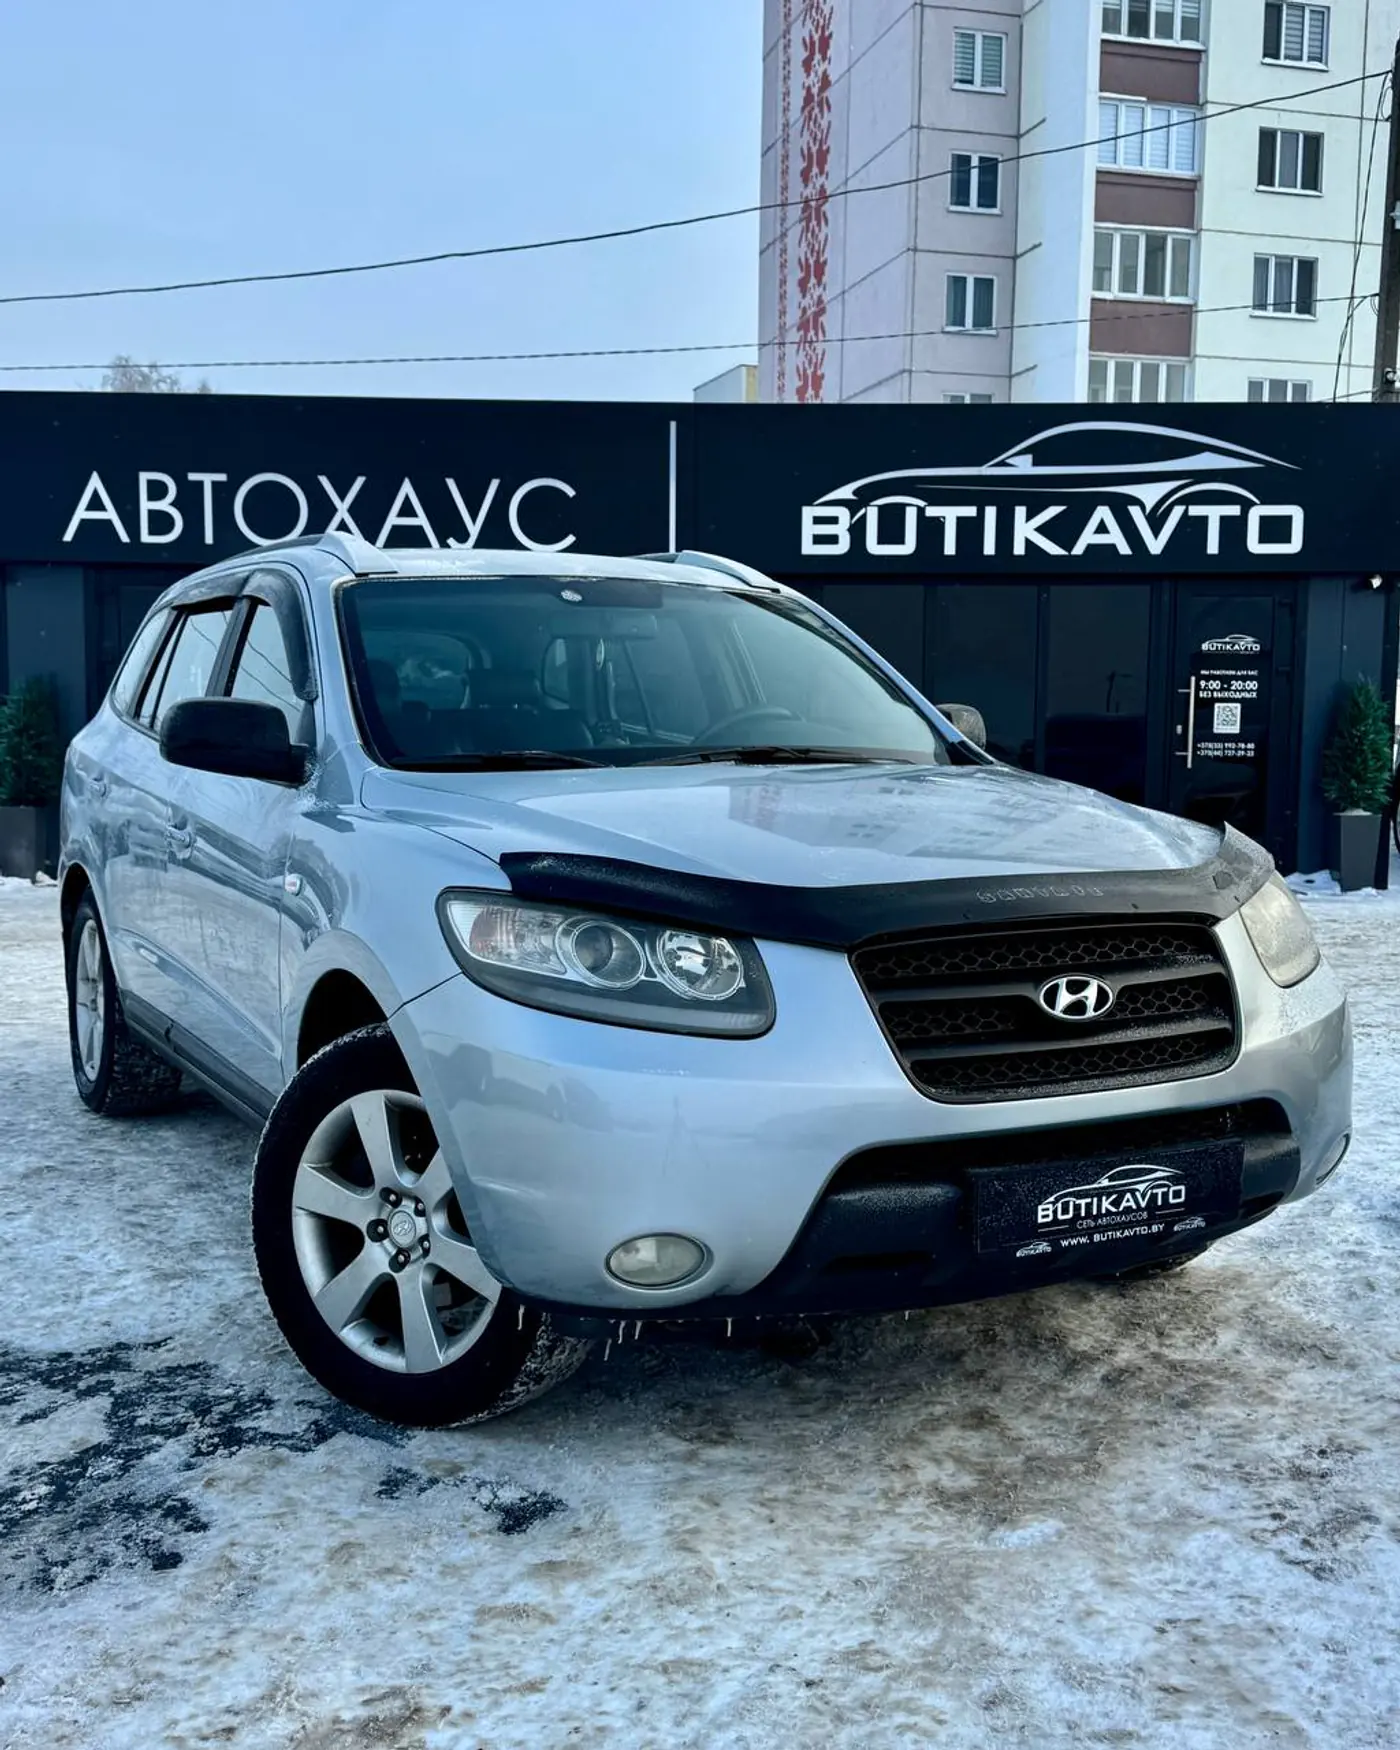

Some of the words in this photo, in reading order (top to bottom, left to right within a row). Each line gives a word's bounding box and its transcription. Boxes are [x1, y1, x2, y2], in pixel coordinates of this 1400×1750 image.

[62, 470, 577, 553] АВТОХАУС
[800, 503, 1305, 556] BUTIKAVTO
[1201, 643, 1260, 651] BUTIKAVTO
[1200, 680, 1220, 690] 9:00
[1230, 680, 1258, 691] 20:00
[1213, 691, 1257, 699] ВЫХОДНЫХ
[1037, 1185, 1186, 1224] BUTIKAVTO
[1076, 1218, 1095, 1229] СЕТЬ
[1097, 1211, 1149, 1226] АВТОХАУСОВ
[1093, 1223, 1165, 1243] BUTIKAVTO.BY
